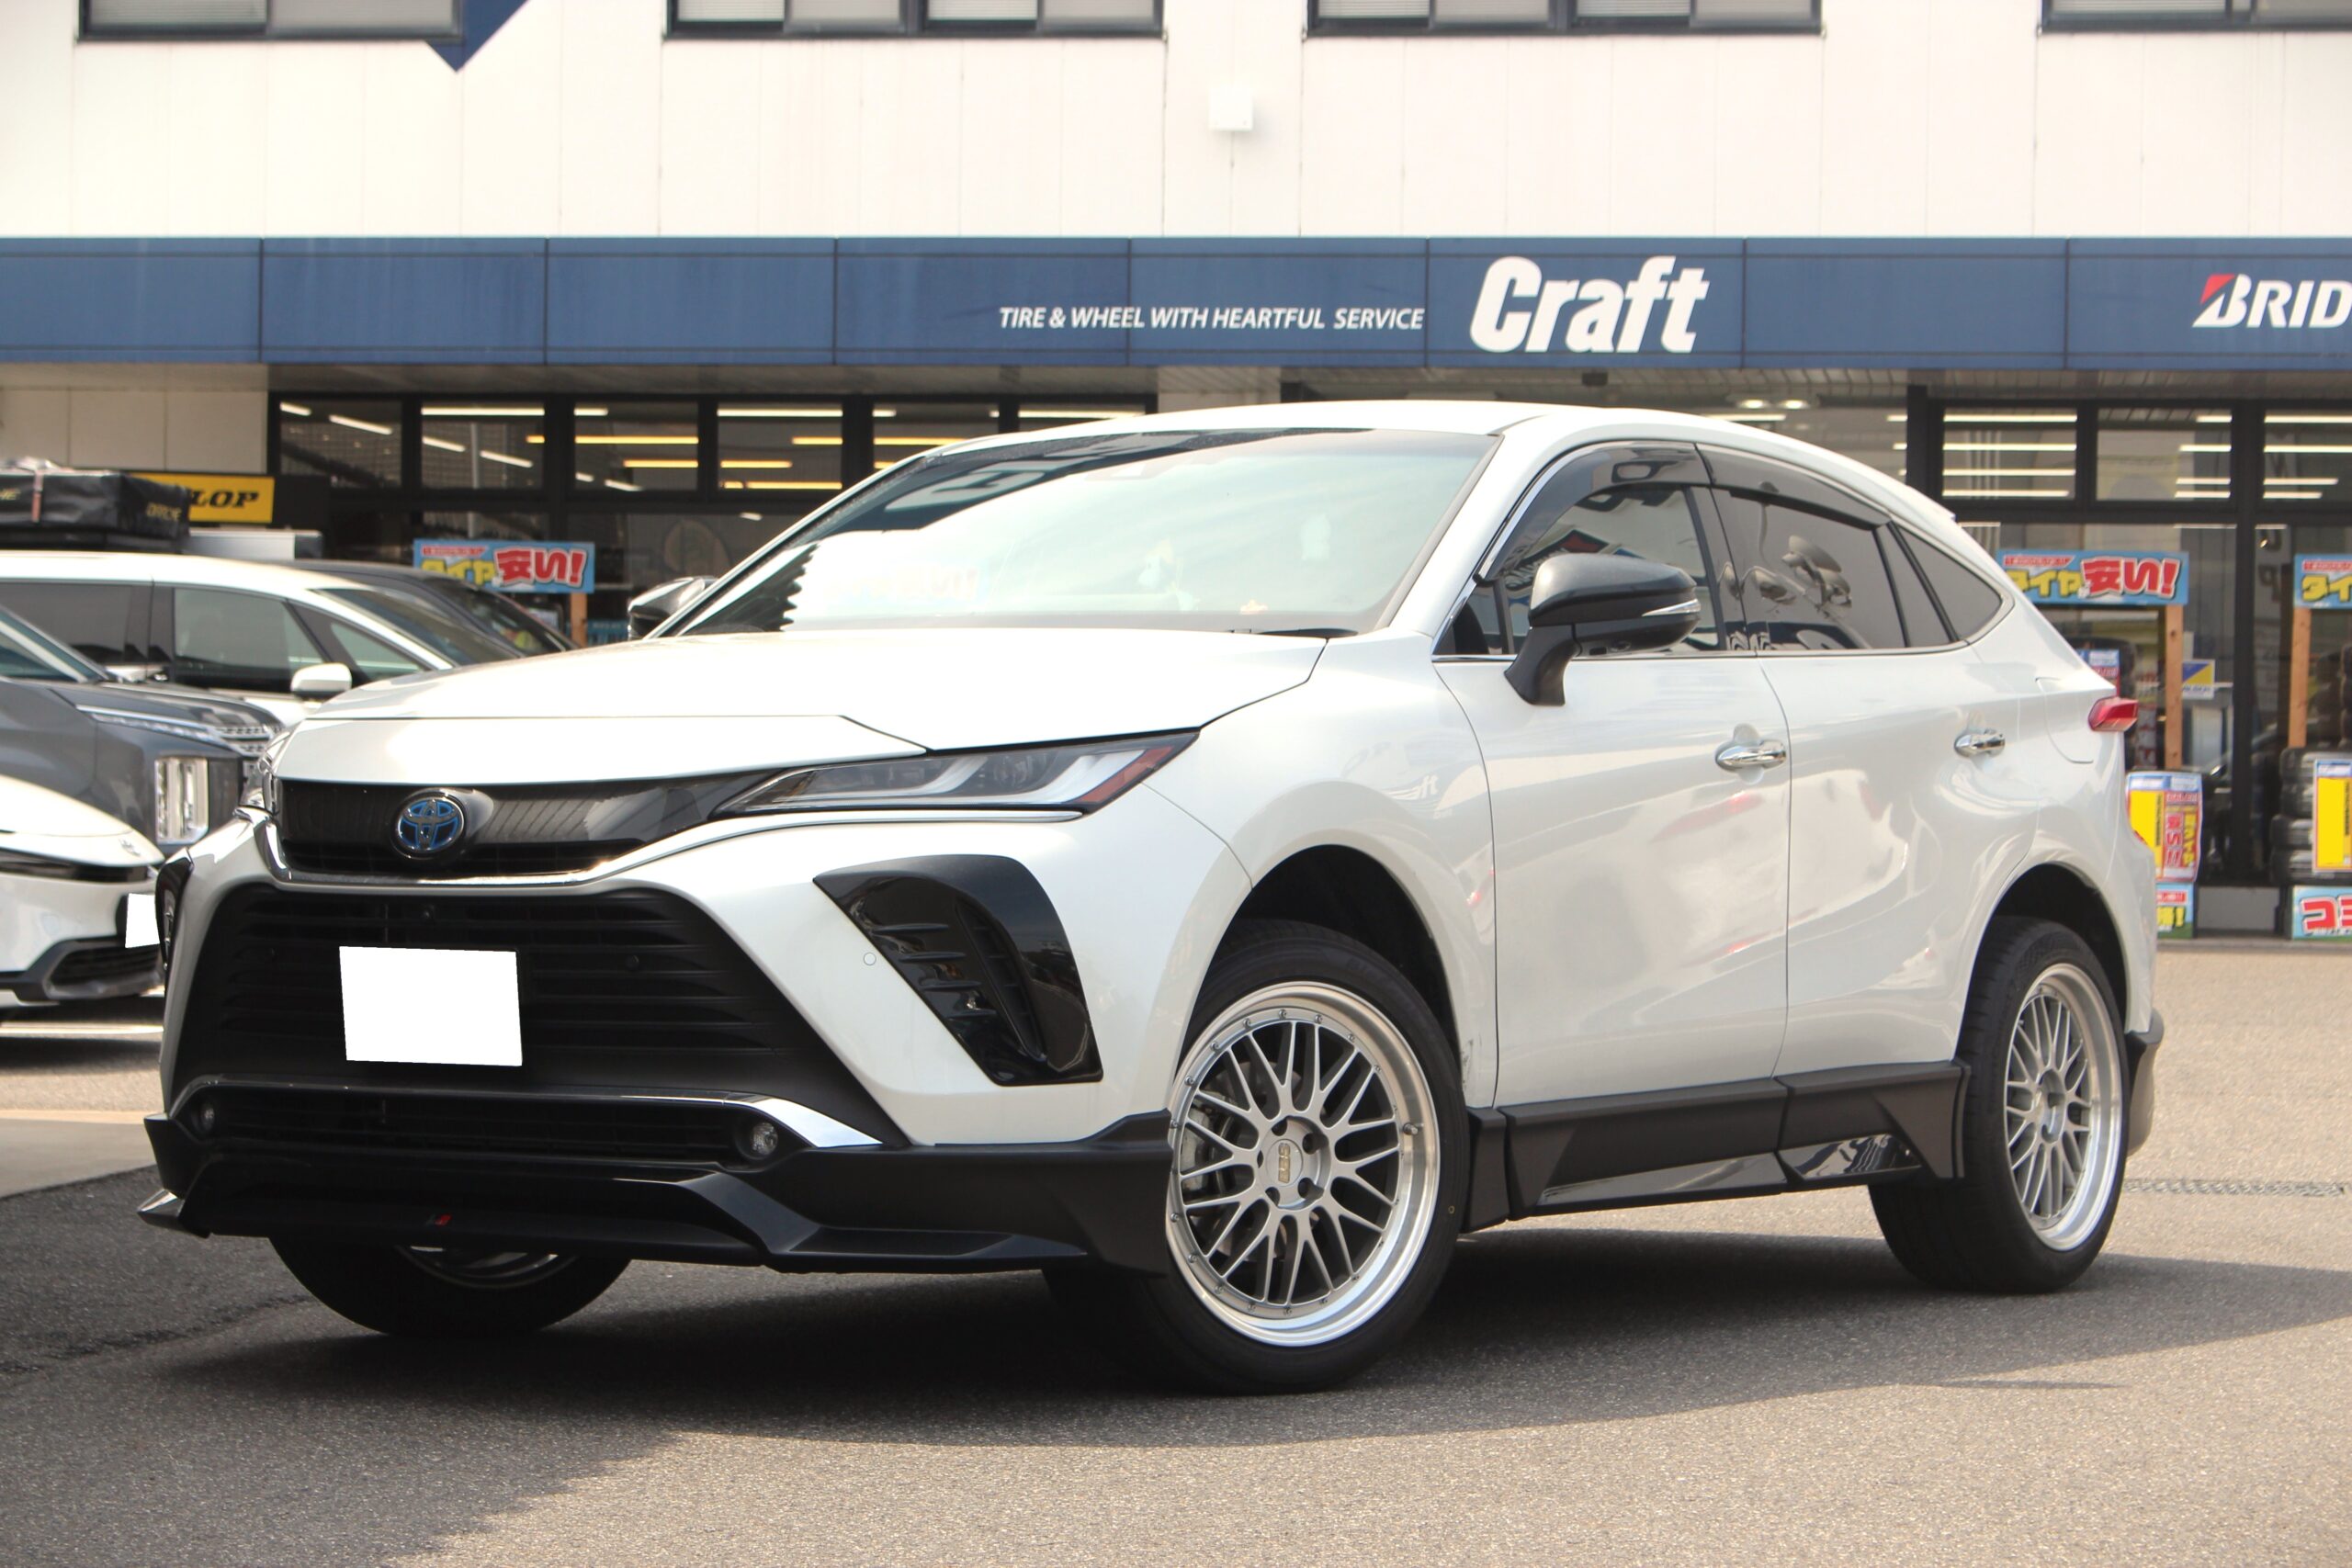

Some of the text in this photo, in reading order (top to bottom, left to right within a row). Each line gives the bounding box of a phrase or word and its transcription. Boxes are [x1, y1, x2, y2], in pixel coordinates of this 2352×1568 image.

[1000, 307, 1425, 330] TIRE & WHEEL WITH HEARTFUL SERVICE
[1469, 255, 1710, 353] Craft
[2192, 273, 2352, 328] BRID
